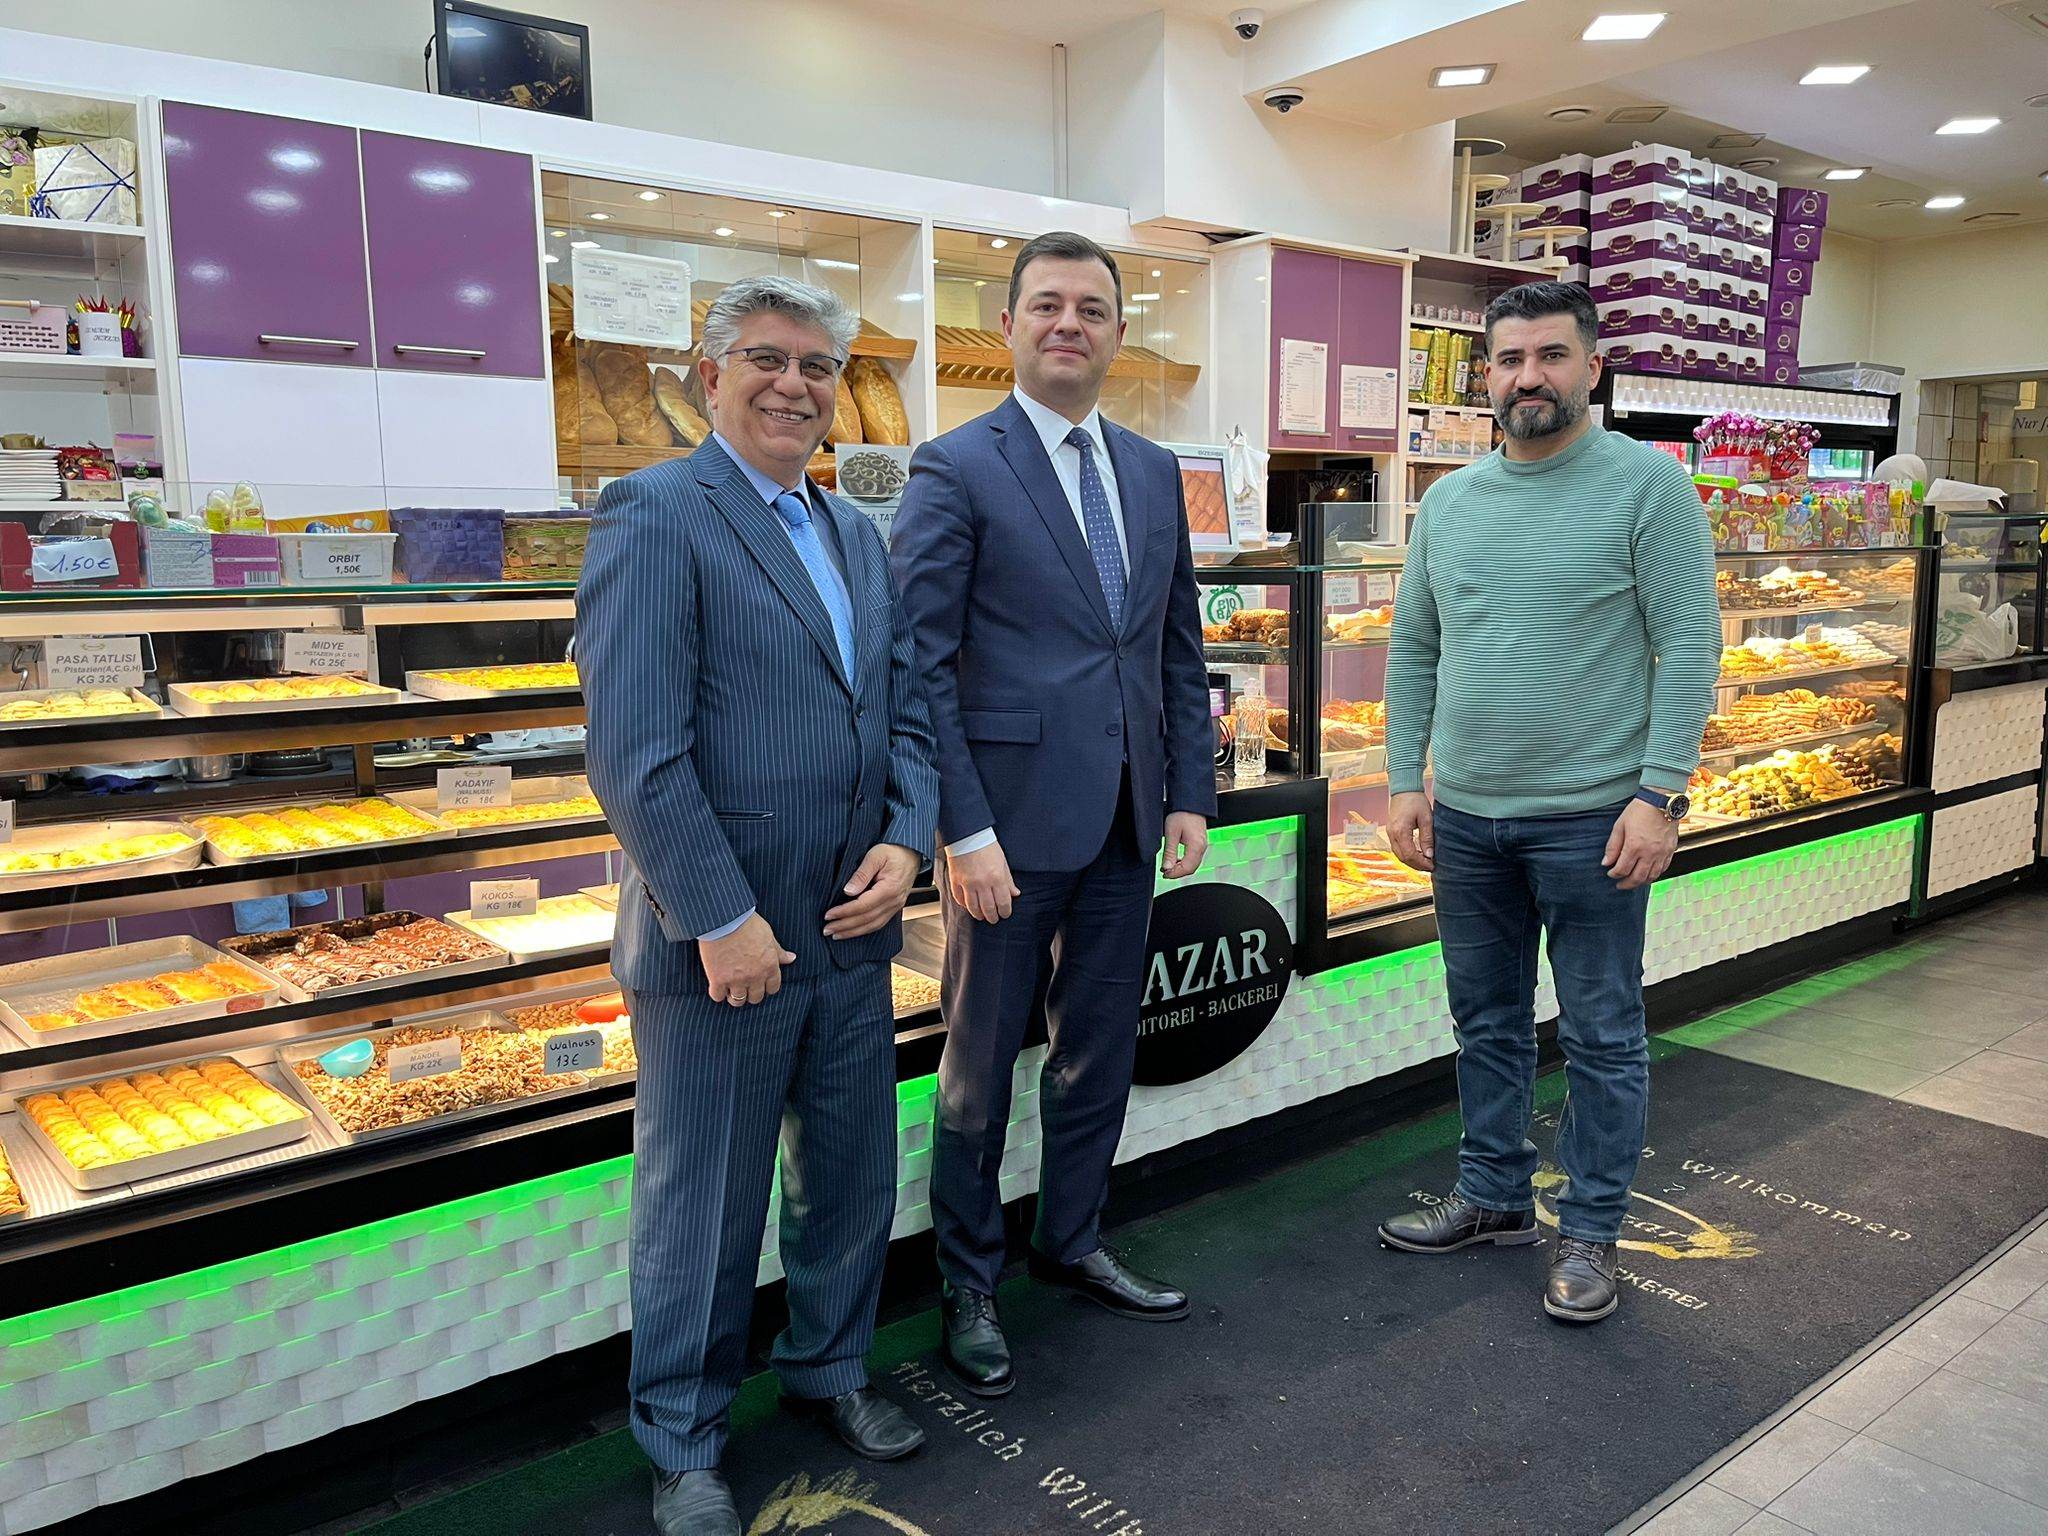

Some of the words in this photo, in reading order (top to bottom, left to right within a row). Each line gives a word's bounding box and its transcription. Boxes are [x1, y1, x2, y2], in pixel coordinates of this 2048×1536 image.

[2016, 416, 2039, 430] Nur
[328, 554, 360, 563] ORBIT
[336, 565, 361, 574] 1,50€
[311, 641, 344, 650] MIDYE
[56, 655, 89, 664] PASA
[92, 653, 136, 664] TATLISI
[309, 658, 325, 666] KG
[327, 659, 346, 667] 25€
[76, 675, 95, 684] KG
[98, 674, 119, 684] 32€
[454, 779, 496, 788] KADAYIF
[455, 796, 469, 805] KG
[480, 795, 495, 804] 18€
[481, 891, 514, 901] KOKOS
[486, 902, 500, 910] KG
[508, 900, 523, 909] 18€
[1208, 983, 1278, 1017] BACKEREI
[410, 1051, 441, 1062] MANDEL
[410, 1062, 425, 1072] KG
[427, 1059, 442, 1069] 22€
